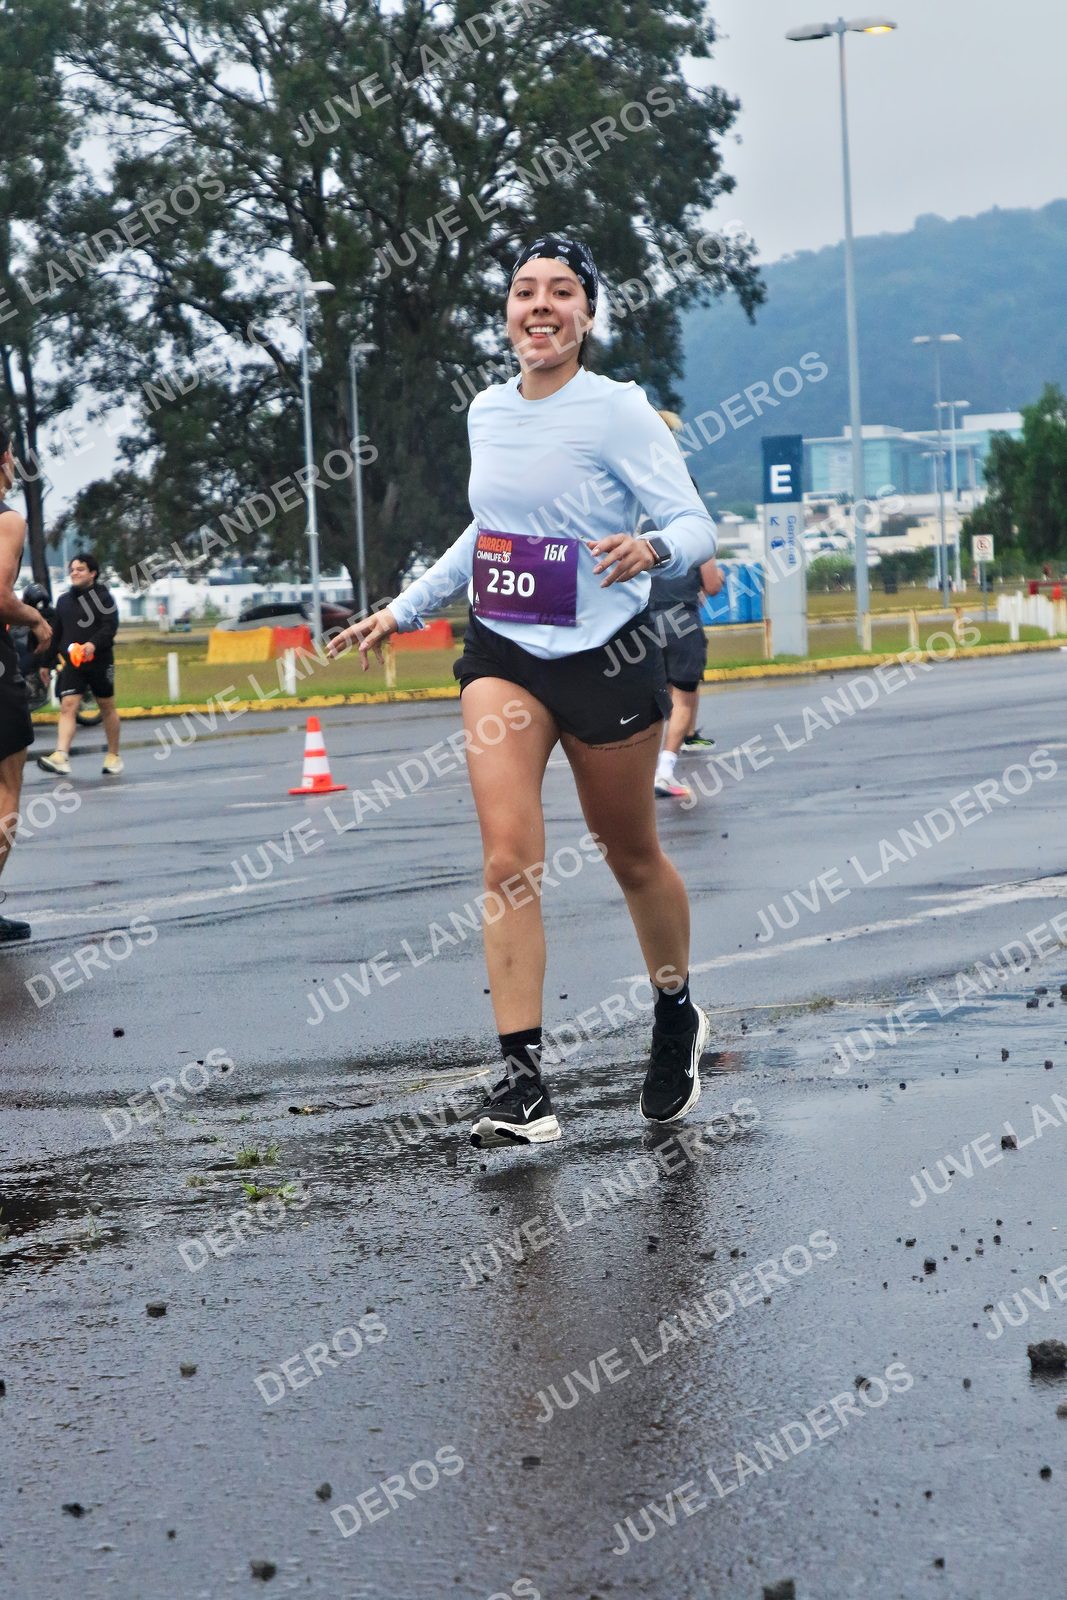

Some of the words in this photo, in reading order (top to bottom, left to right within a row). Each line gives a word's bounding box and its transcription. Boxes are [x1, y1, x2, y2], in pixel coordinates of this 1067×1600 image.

[770, 464, 793, 494] E
[478, 535, 513, 552] CARRERA
[544, 544, 568, 562] 15K
[486, 568, 535, 597] 230
